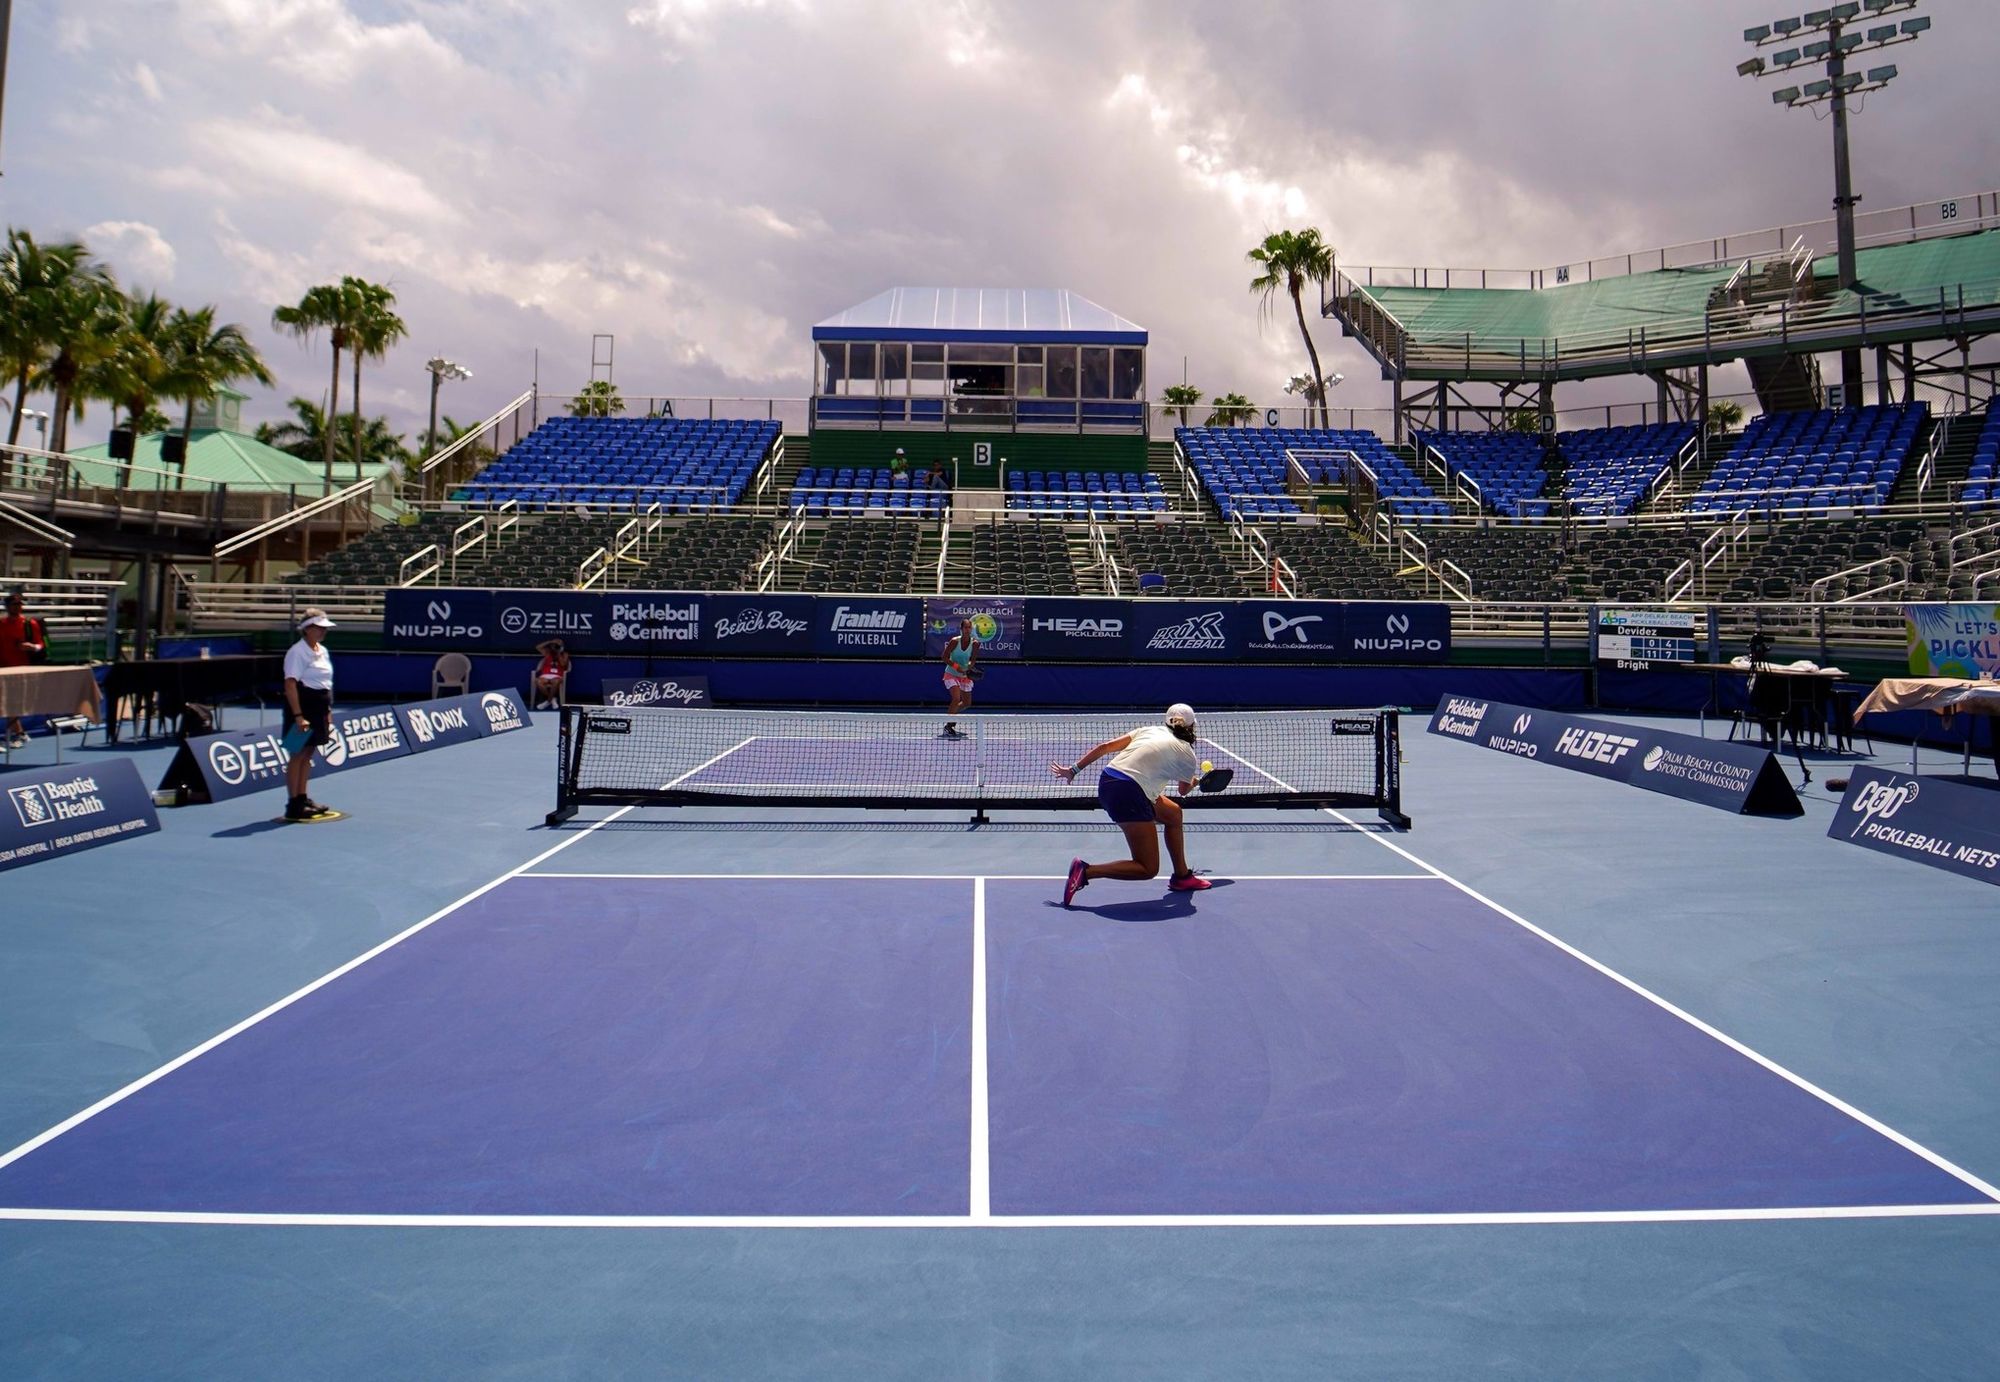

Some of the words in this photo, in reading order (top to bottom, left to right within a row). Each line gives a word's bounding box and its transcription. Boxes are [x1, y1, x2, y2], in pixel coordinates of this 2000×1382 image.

[1941, 202, 1957, 219] BB
[1556, 268, 1569, 283] AA
[1829, 387, 1842, 406] E
[661, 400, 673, 417] A
[1267, 409, 1278, 426] C
[1542, 415, 1554, 432] D
[976, 444, 989, 463] B
[612, 604, 699, 621] Pickleball
[952, 607, 984, 615] DELRAY
[986, 607, 1014, 616] BEACH
[1670, 613, 1693, 621] BEACH
[393, 625, 483, 638] NIUPIPO
[628, 622, 693, 640] Central
[715, 611, 765, 640] Beach
[766, 610, 809, 637] Boyz
[1032, 618, 1123, 631] HEAD
[1617, 626, 1657, 636] Devidez
[1955, 621, 1998, 635] LET'S
[837, 633, 898, 646] PICKLEBALL
[996, 642, 1021, 651] OPEN
[1145, 639, 1225, 649] PICKLEBALL
[1354, 638, 1442, 651] NIUPIPO
[1648, 639, 1655, 647] 0
[1665, 640, 1672, 648] 4
[1647, 650, 1657, 658] 11
[1665, 651, 1672, 659] 7
[1931, 638, 2000, 659] PICKL
[1617, 660, 1649, 671] Bright
[662, 681, 704, 705] Boyz
[485, 705, 509, 723] USA
[1445, 698, 1488, 720] Pickleball
[343, 712, 395, 736] SPORTS
[430, 707, 468, 732] ONIX
[491, 718, 523, 733] PICKLEBALL
[591, 719, 627, 728] HEAD
[349, 730, 400, 757] LIGHTING
[1489, 735, 1538, 757] NIUPIPO
[1662, 750, 1682, 764] PALM
[1684, 754, 1712, 771] BEACH
[1713, 760, 1754, 781] COUNTY
[1657, 760, 1685, 778] SPORTS
[1687, 768, 1748, 793] COMMISSION
[43, 777, 99, 800] Baptist
[54, 796, 105, 820] Health
[16, 842, 49, 857] HOSPITAL
[55, 836, 74, 848] BOCA
[73, 830, 94, 843] RATON
[93, 825, 122, 839] REGIONAL
[121, 819, 148, 833] HOSPITAL
[1864, 823, 1952, 858] PICKLEBALL
[1953, 845, 2000, 869] NETS
